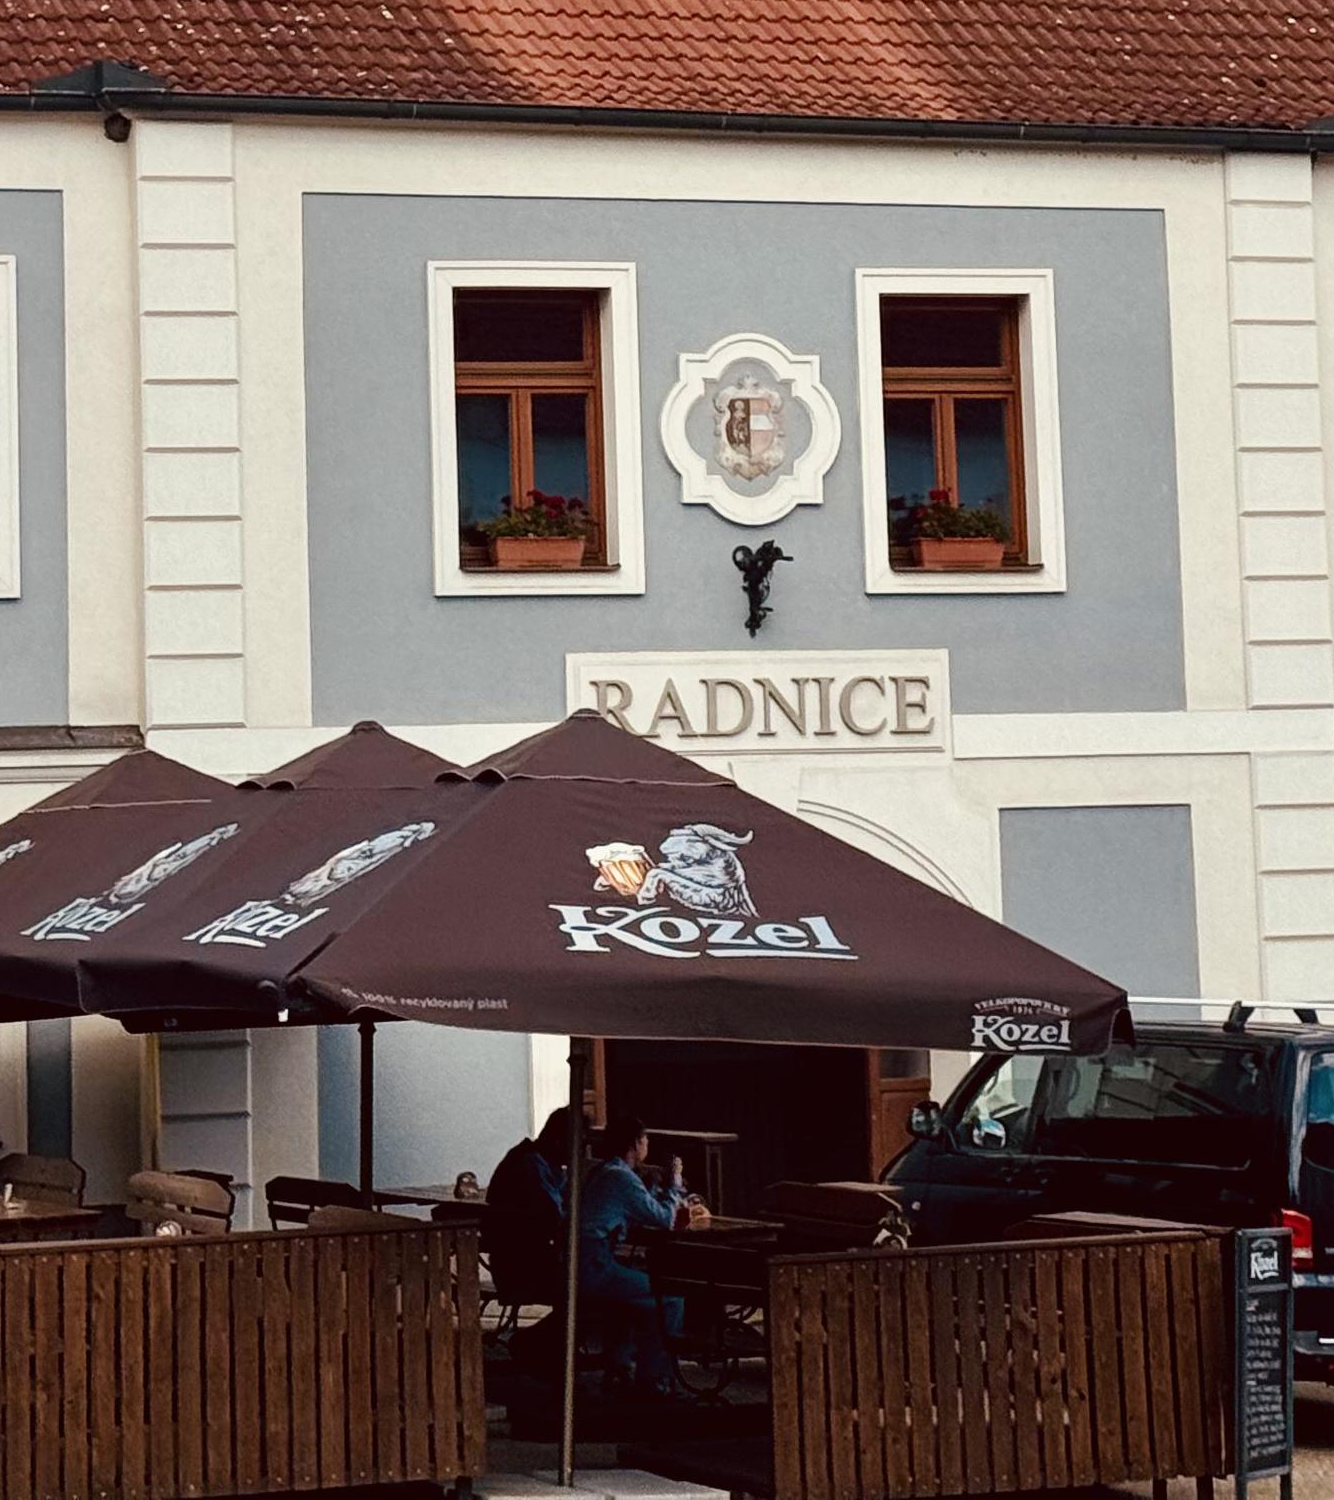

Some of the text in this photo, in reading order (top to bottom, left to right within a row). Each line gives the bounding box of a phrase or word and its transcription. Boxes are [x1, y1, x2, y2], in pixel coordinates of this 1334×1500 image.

[589, 676, 935, 738] RADNICE
[548, 904, 859, 959] Kozel
[970, 1015, 1072, 1051] Kozel
